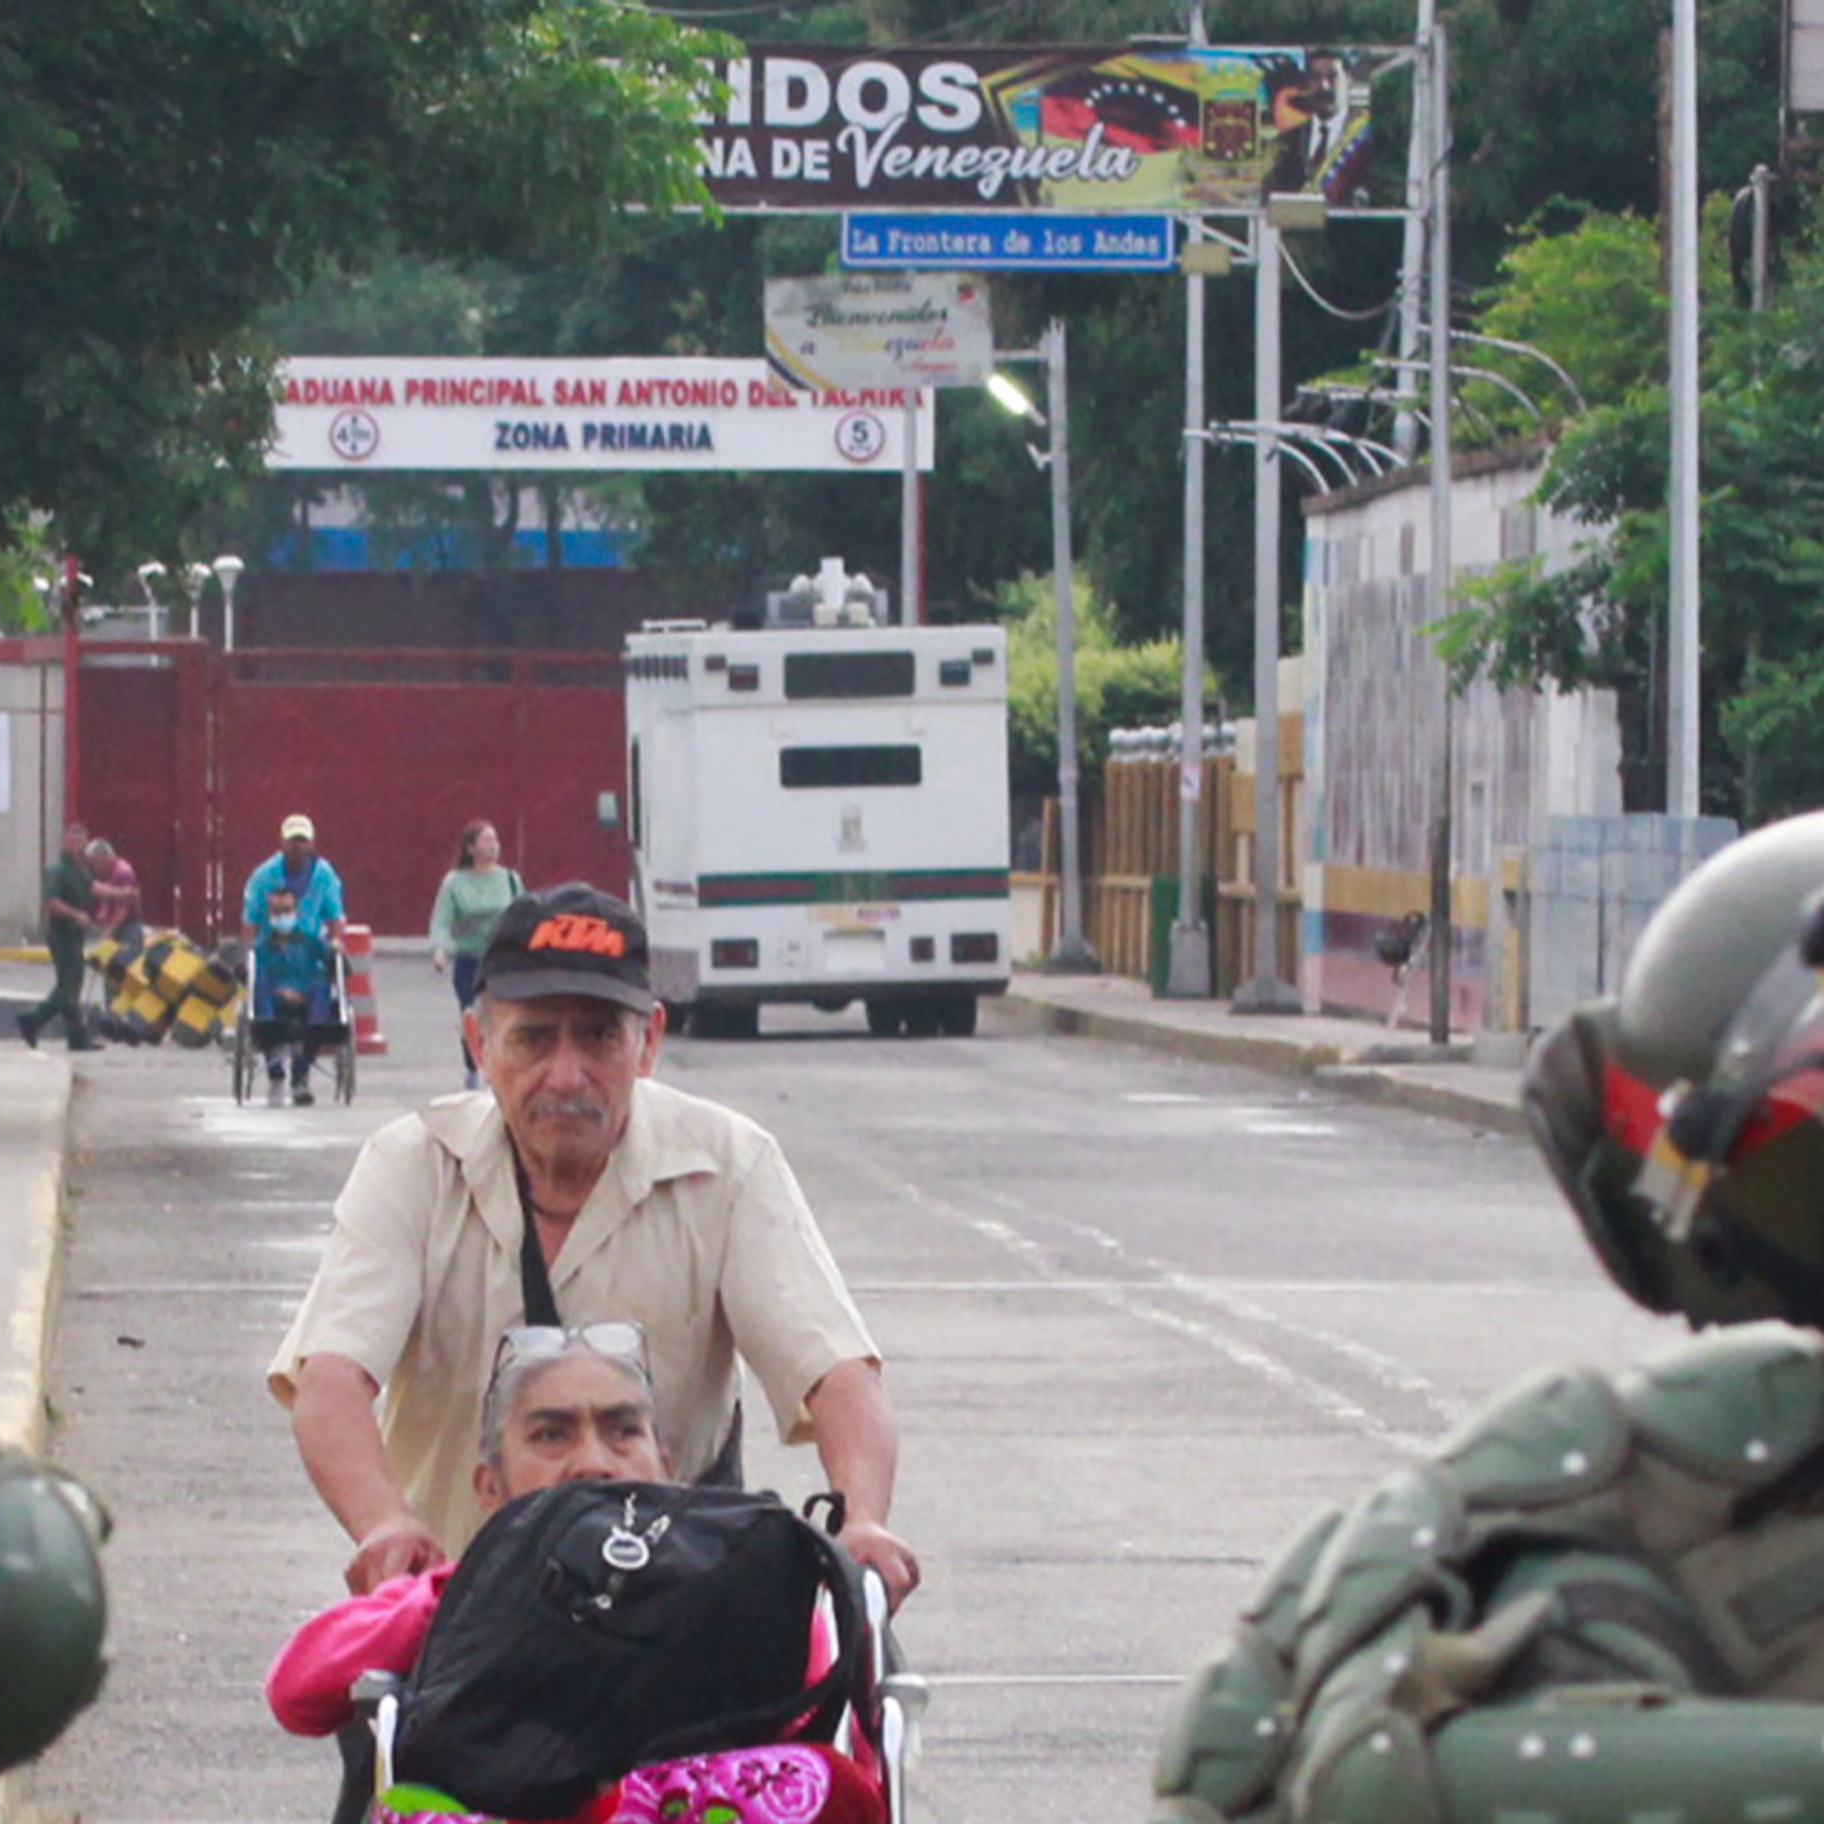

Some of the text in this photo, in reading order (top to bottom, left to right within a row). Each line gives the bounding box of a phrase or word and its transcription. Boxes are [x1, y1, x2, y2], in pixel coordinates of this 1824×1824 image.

[772, 138, 830, 180] DE
[837, 114, 1138, 200] Venezuela
[852, 229, 1160, 255] La Frontera de los Andes
[285, 378, 396, 406] ADUANA
[404, 378, 545, 406] PRINCIPAL
[553, 378, 607, 406] SAN
[616, 379, 739, 407] ANTONIO
[493, 421, 714, 451] ZONA PRIMARIA
[851, 420, 869, 444] 5
[528, 914, 626, 959] KTM
